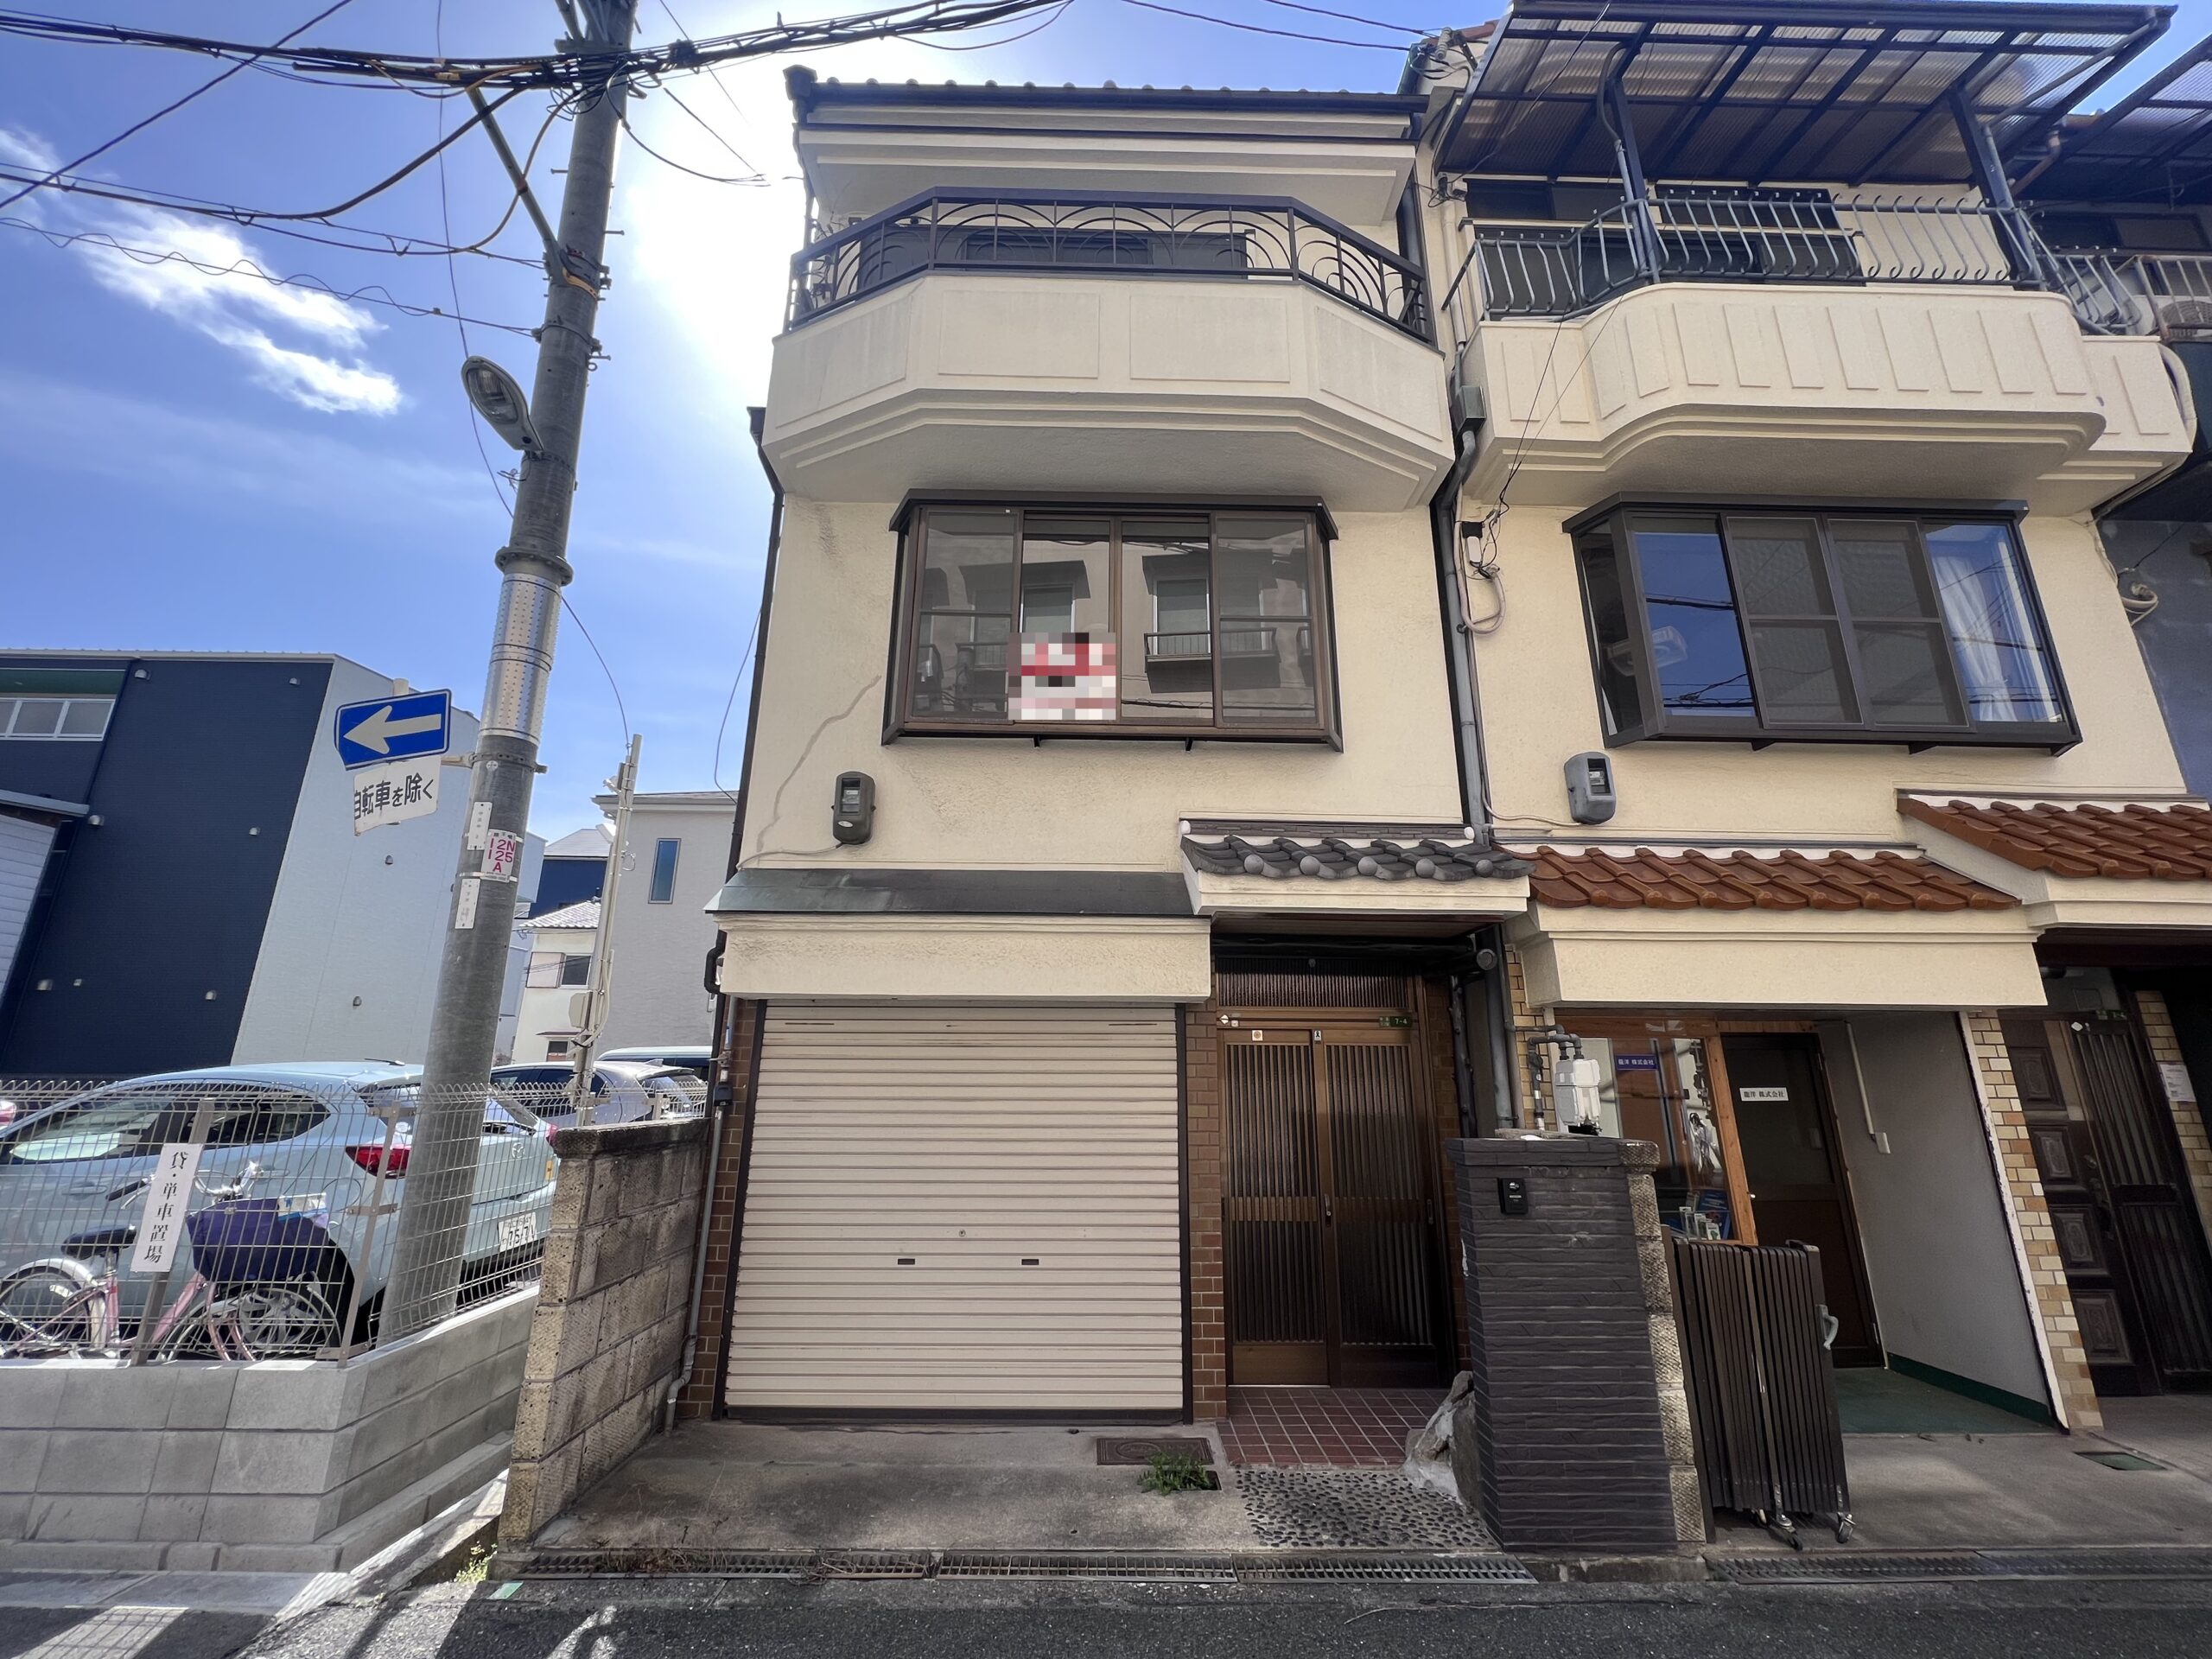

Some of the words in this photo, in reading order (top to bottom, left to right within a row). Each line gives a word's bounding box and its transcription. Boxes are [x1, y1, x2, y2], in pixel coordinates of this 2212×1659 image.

[354, 772, 434, 821] 自転車を除く
[493, 861, 502, 873] A
